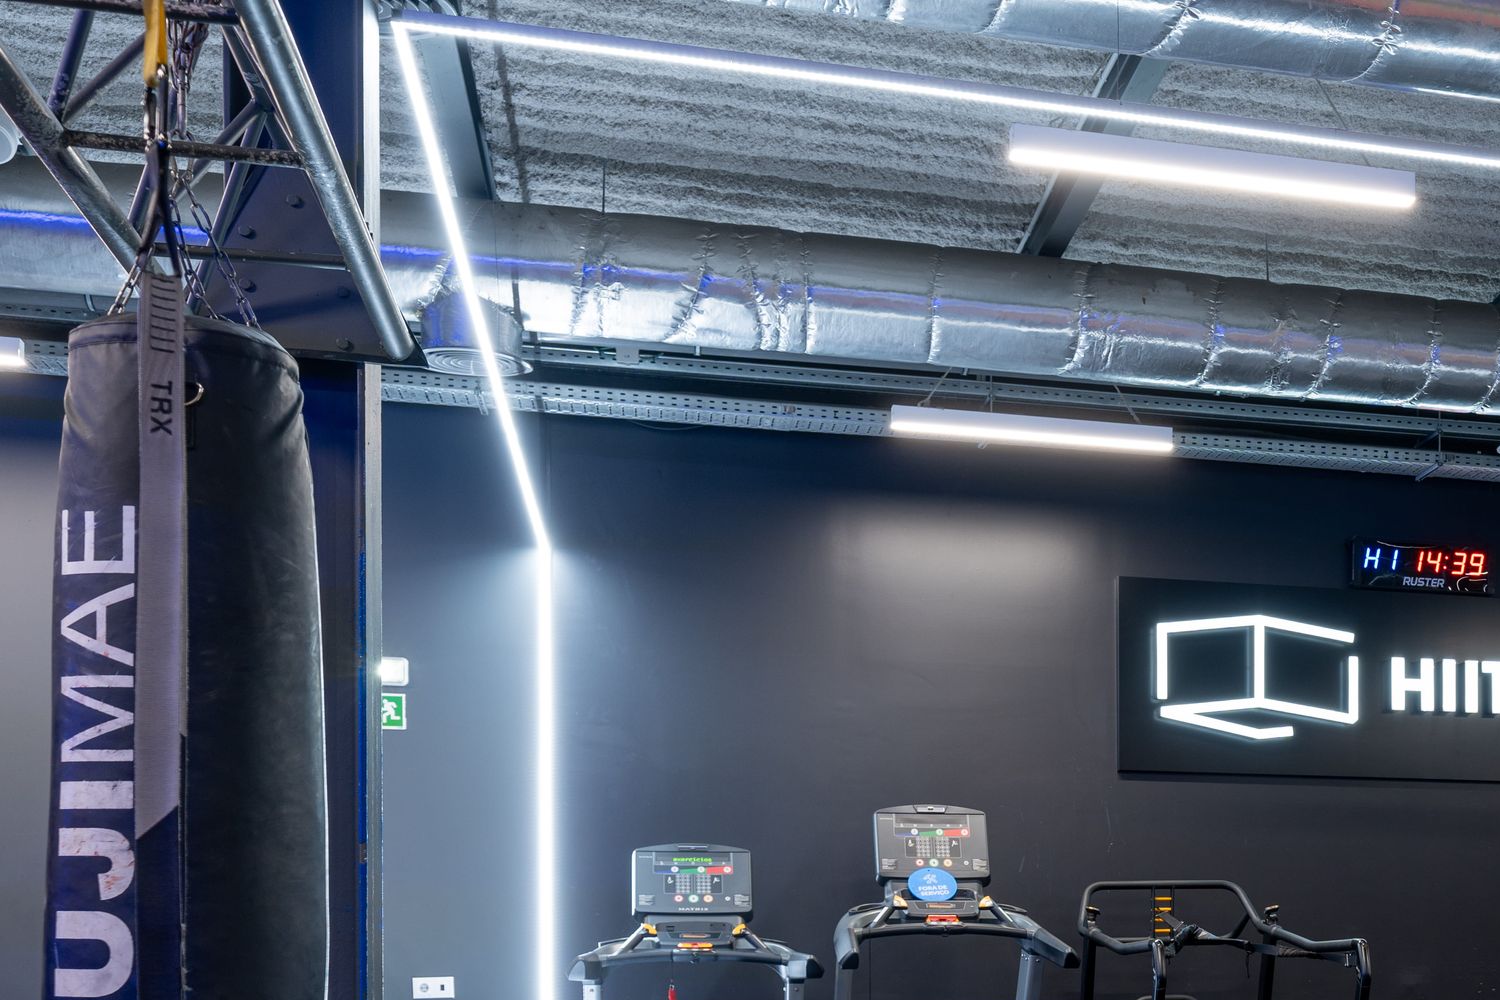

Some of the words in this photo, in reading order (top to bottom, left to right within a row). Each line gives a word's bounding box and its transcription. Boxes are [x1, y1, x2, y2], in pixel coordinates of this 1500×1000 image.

[150, 381, 173, 436] TRX
[1416, 551, 1485, 576] 14:39
[1402, 576, 1445, 588] RUSTER
